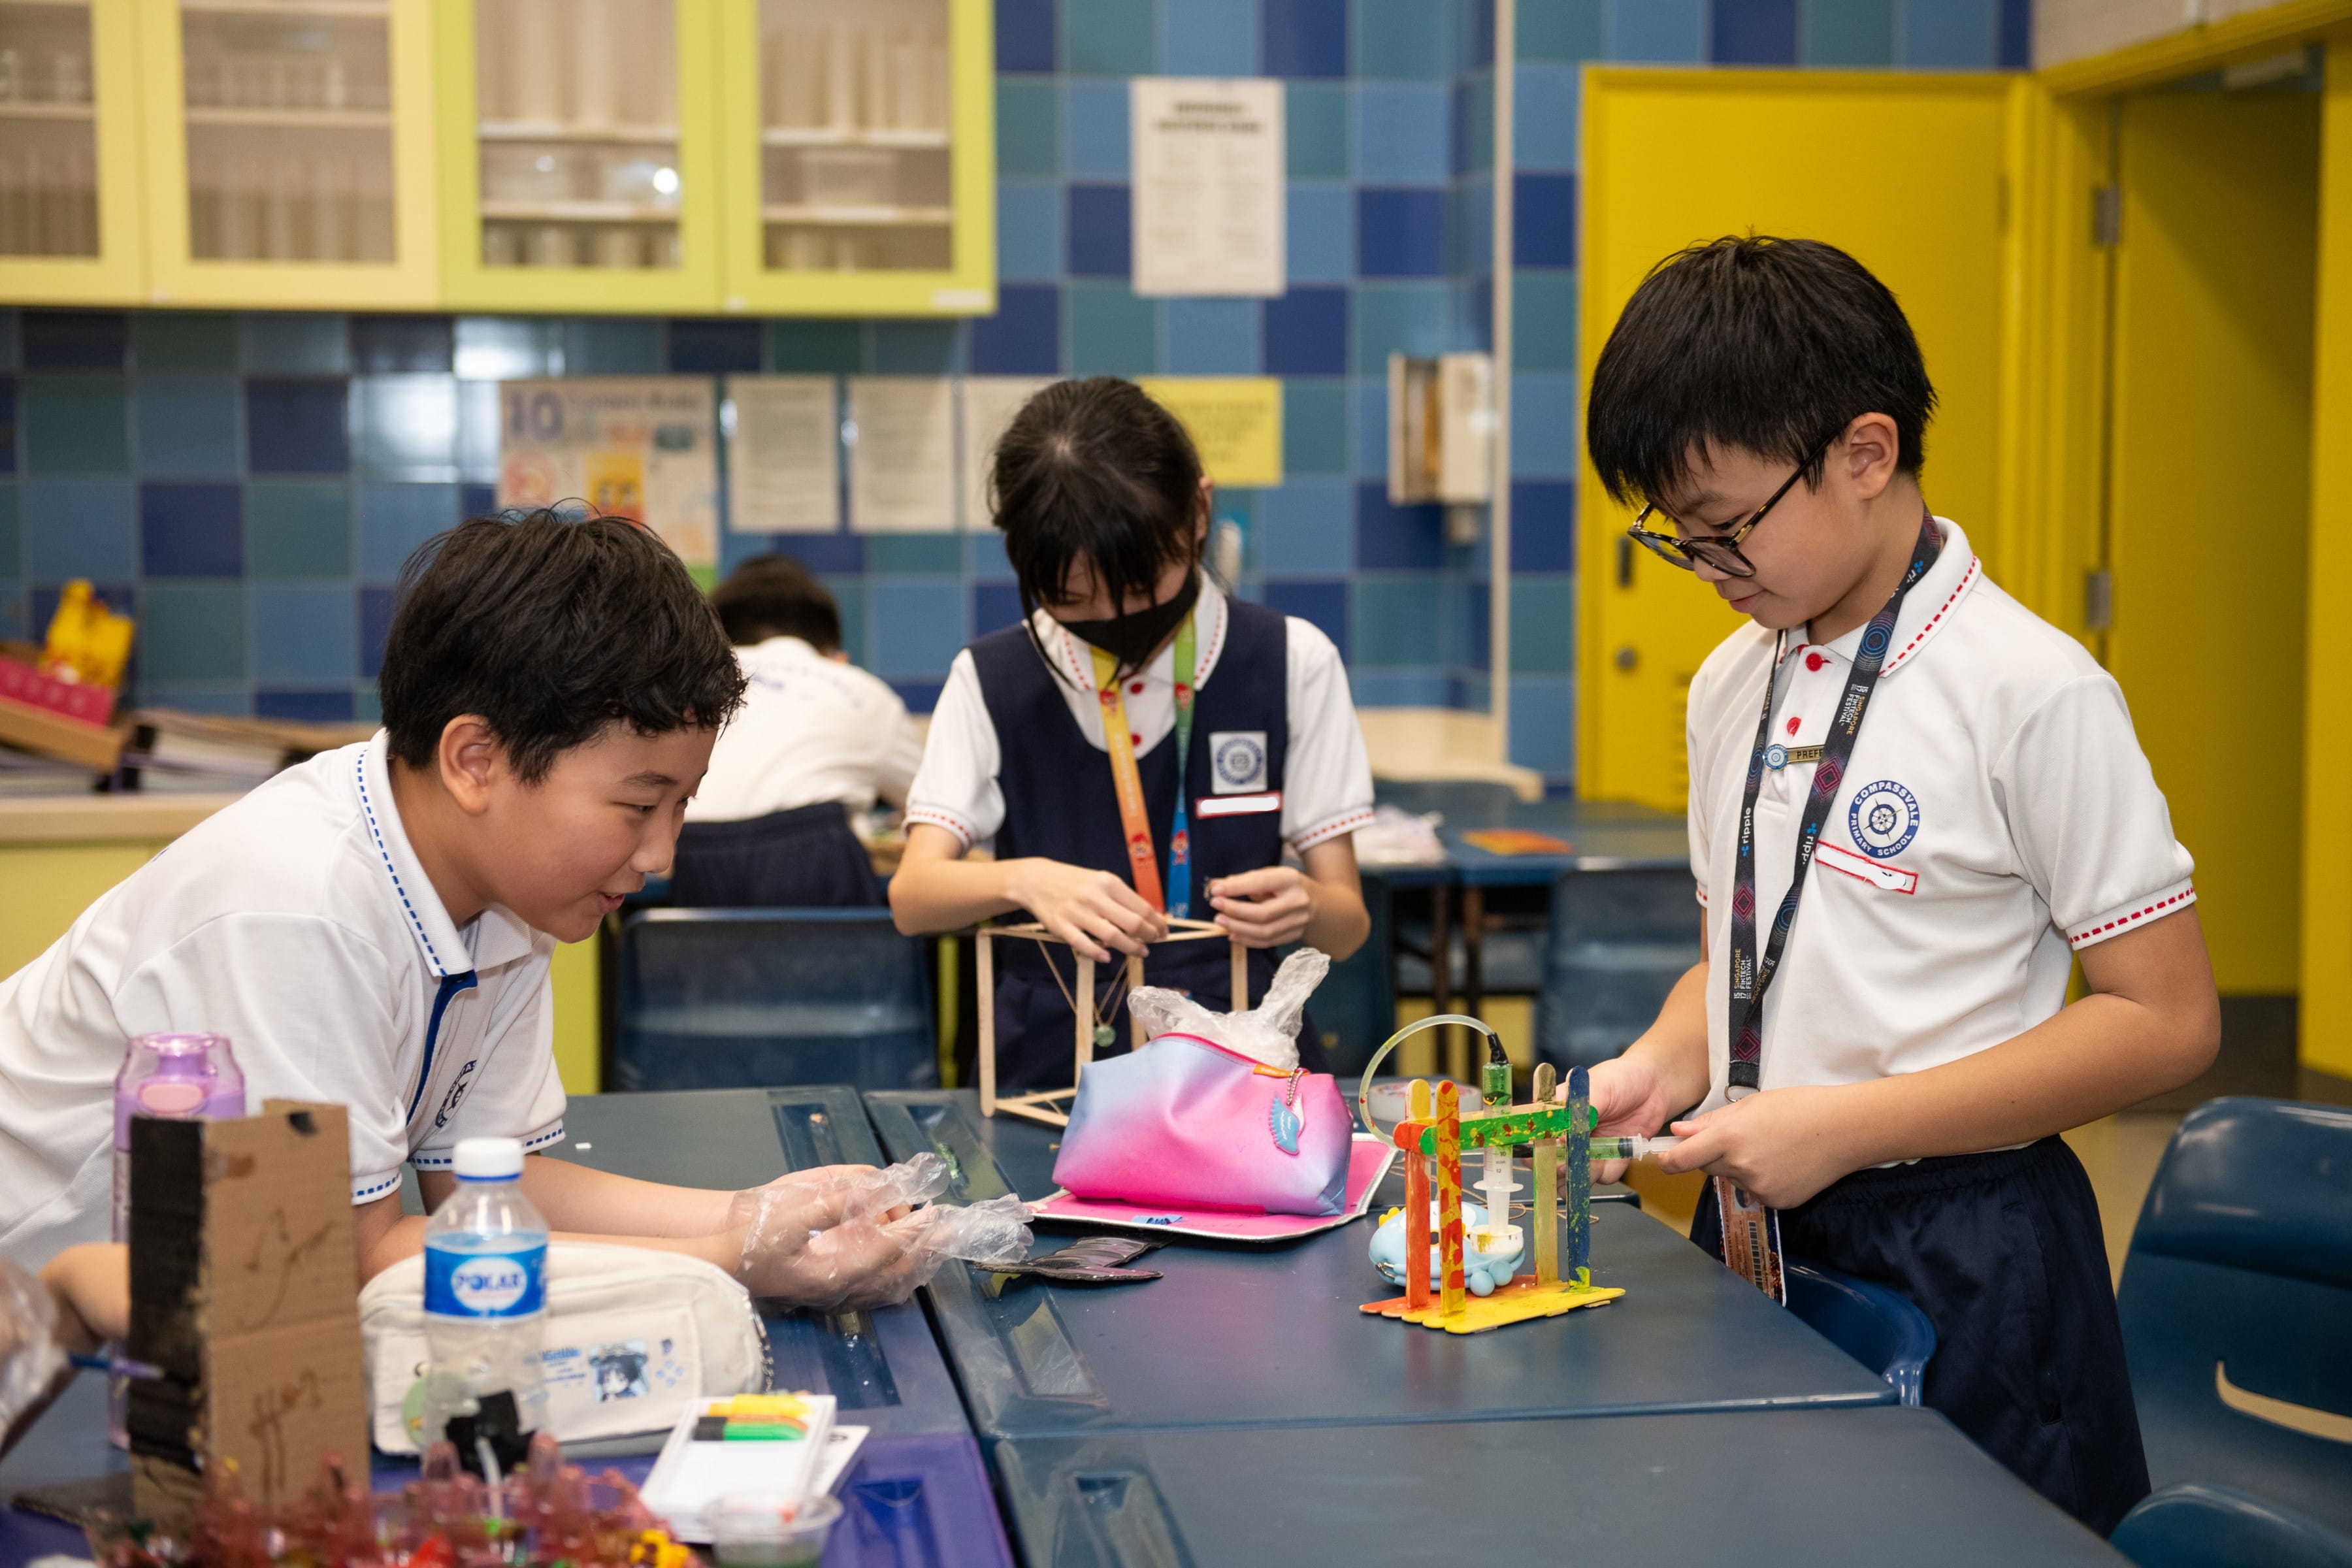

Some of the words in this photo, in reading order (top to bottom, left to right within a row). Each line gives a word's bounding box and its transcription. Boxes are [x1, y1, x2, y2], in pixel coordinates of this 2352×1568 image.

[1845, 694, 1859, 723] FINTECH
[1846, 695, 1865, 735] SINGAPORE
[1855, 781, 1918, 826] COMPASSVALE
[1742, 808, 1752, 844] ripple
[1851, 813, 1872, 852] PRIMARY
[1878, 835, 1912, 856] SCHOOL
[1801, 836, 1814, 864] ripp
